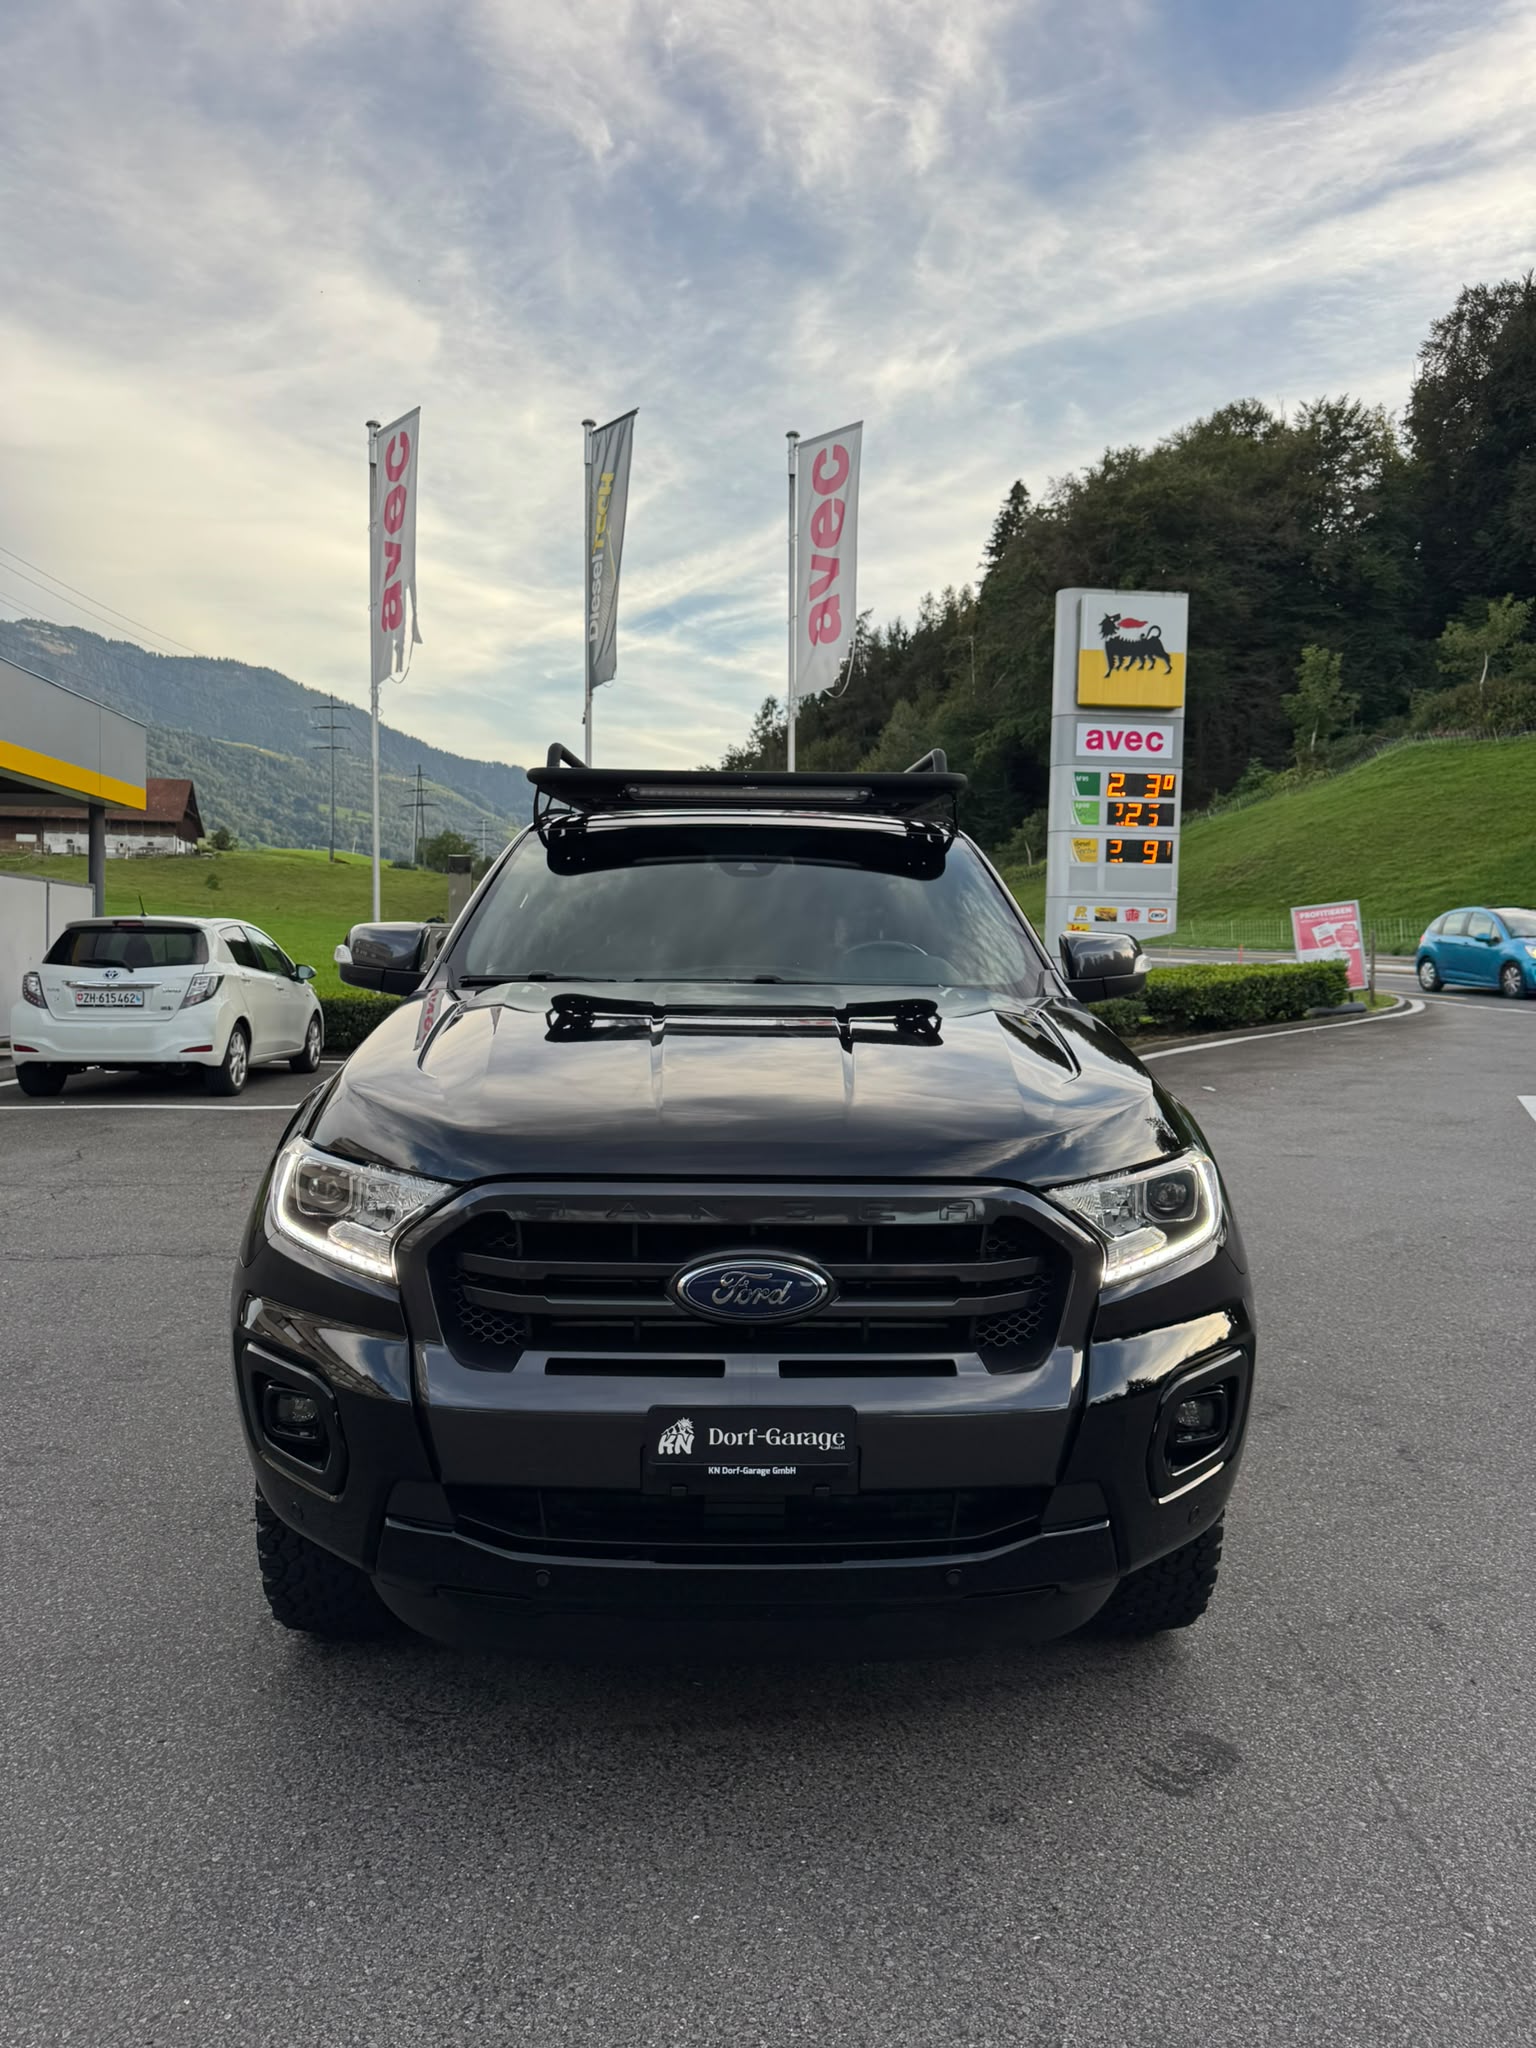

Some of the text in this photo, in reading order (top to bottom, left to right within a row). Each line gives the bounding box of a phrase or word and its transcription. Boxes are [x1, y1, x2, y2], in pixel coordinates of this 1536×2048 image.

[381, 431, 410, 632] avec
[808, 444, 850, 647] avec
[1085, 729, 1164, 752] avec
[711, 1271, 793, 1305] Ford
[658, 1433, 695, 1455] KN
[708, 1428, 846, 1451] Dorf-Garage
[708, 1466, 797, 1477] KN Dorf-Garage GmbH
